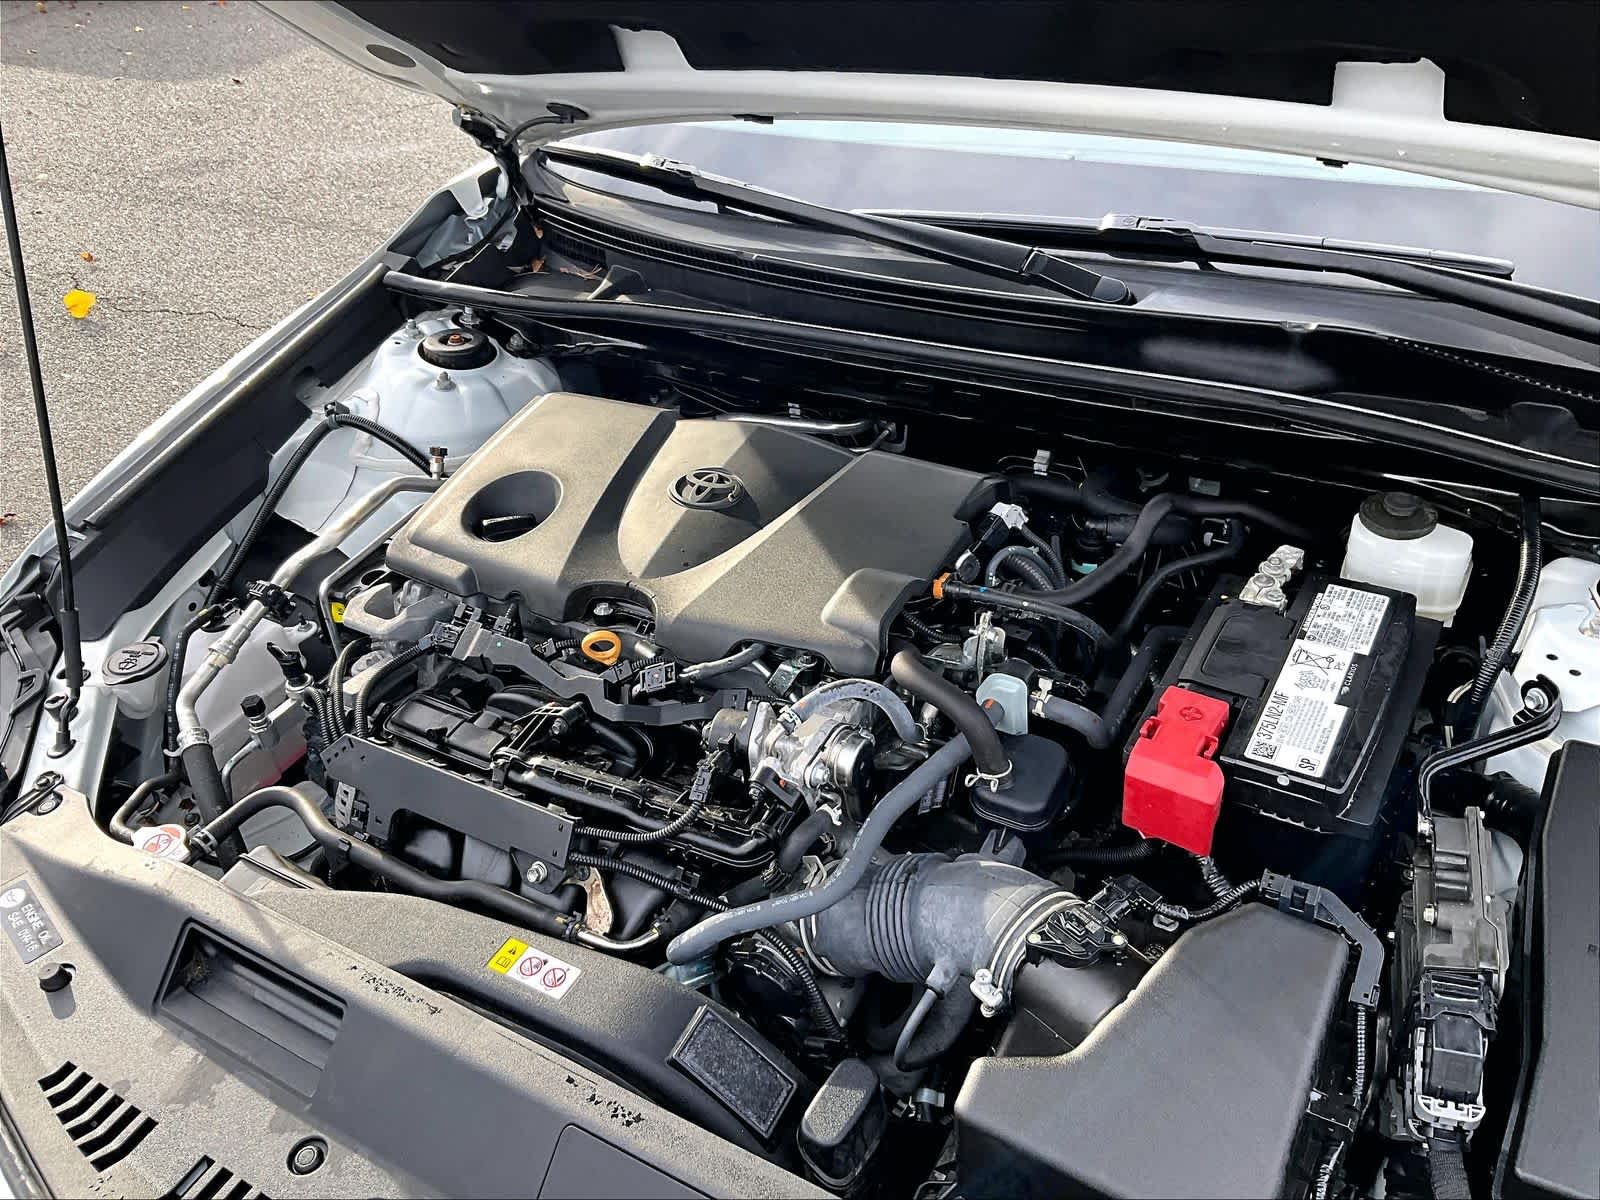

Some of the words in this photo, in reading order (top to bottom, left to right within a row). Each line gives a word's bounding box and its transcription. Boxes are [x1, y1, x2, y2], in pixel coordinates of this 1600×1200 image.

[1256, 690, 1289, 740] 375LN2-MF
[1298, 758, 1317, 771] SP
[7, 911, 25, 929] SAE
[21, 903, 44, 930] ENGINE
